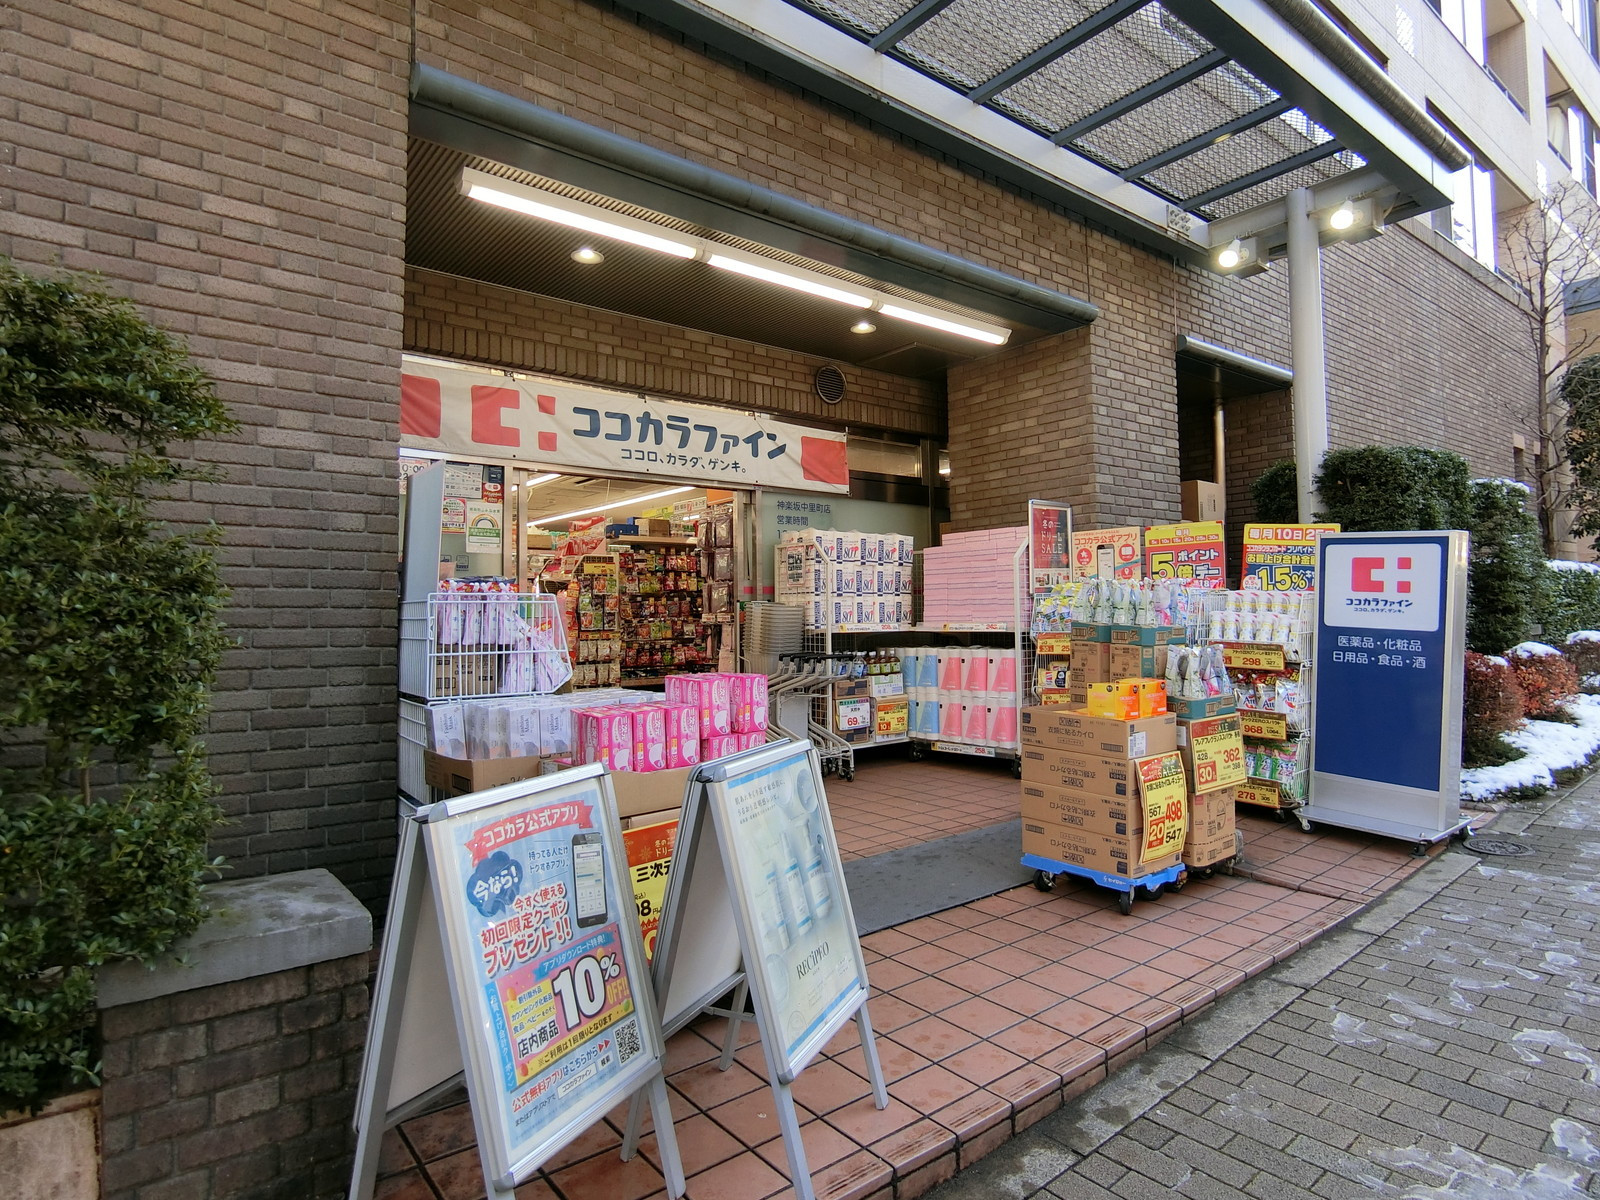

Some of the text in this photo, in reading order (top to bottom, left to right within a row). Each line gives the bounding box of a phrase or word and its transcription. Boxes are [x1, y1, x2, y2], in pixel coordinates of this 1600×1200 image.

[572, 406, 787, 460] ココカラファイン
[621, 448, 747, 474] ココロ、カラダ、ゲンキ。
[777, 500, 832, 514] 神楽坂中里町店
[776, 514, 809, 526] 営業時間
[1041, 531, 1063, 542] ドリーム
[1074, 533, 1138, 546] ココカラ公式アプリ
[1249, 528, 1273, 539] 毎月
[1275, 528, 1303, 540] 10日
[1041, 543, 1063, 554] SALE
[1177, 548, 1219, 562] ポイント
[1151, 551, 1221, 580] 5 倍デー
[1257, 565, 1307, 592] 1.5%
[1345, 597, 1413, 608] ココカラファイン
[1337, 635, 1422, 652] 医薬品・化粧品
[1242, 657, 1261, 666] 298
[1332, 651, 1426, 669] 日用品・食品・酒
[847, 716, 858, 726] 69
[1244, 724, 1263, 735] 968
[1048, 726, 1094, 739] 衣類に貼るカイロ
[1197, 752, 1209, 760] 428
[1223, 747, 1240, 763] 362
[1049, 764, 1096, 779] 衣類に貼るカイロ
[1200, 766, 1213, 783] 30
[1237, 790, 1256, 801] 278
[1049, 801, 1096, 818] 衣類に貼るカイロ
[1149, 805, 1161, 818] 567
[1165, 800, 1183, 823] 498
[483, 805, 578, 847] ココカラ公式アプリ
[1150, 822, 1164, 841] 20
[1165, 828, 1182, 844] 547
[528, 846, 569, 861] 持ってる人だけ
[1050, 839, 1097, 856] 衣類に貼るカイロ
[473, 865, 519, 901] 今なら!
[514, 883, 565, 911] 今すぐ使える
[481, 899, 567, 948] 初回限定クーポン
[484, 917, 572, 975] プレゼント!!
[543, 933, 606, 971] アプリダウンロード特典!
[552, 952, 621, 1032] 10%
[606, 976, 630, 1004] OFF!!
[511, 993, 553, 1022] カウンセリング化粧品
[517, 1019, 559, 1059] 店内商品
[537, 1013, 613, 1066] ※ご利用は1回限りとなります
[512, 1045, 599, 1113] 公式無料アプリはこちらから
[562, 1068, 592, 1093] ココカラファイン
